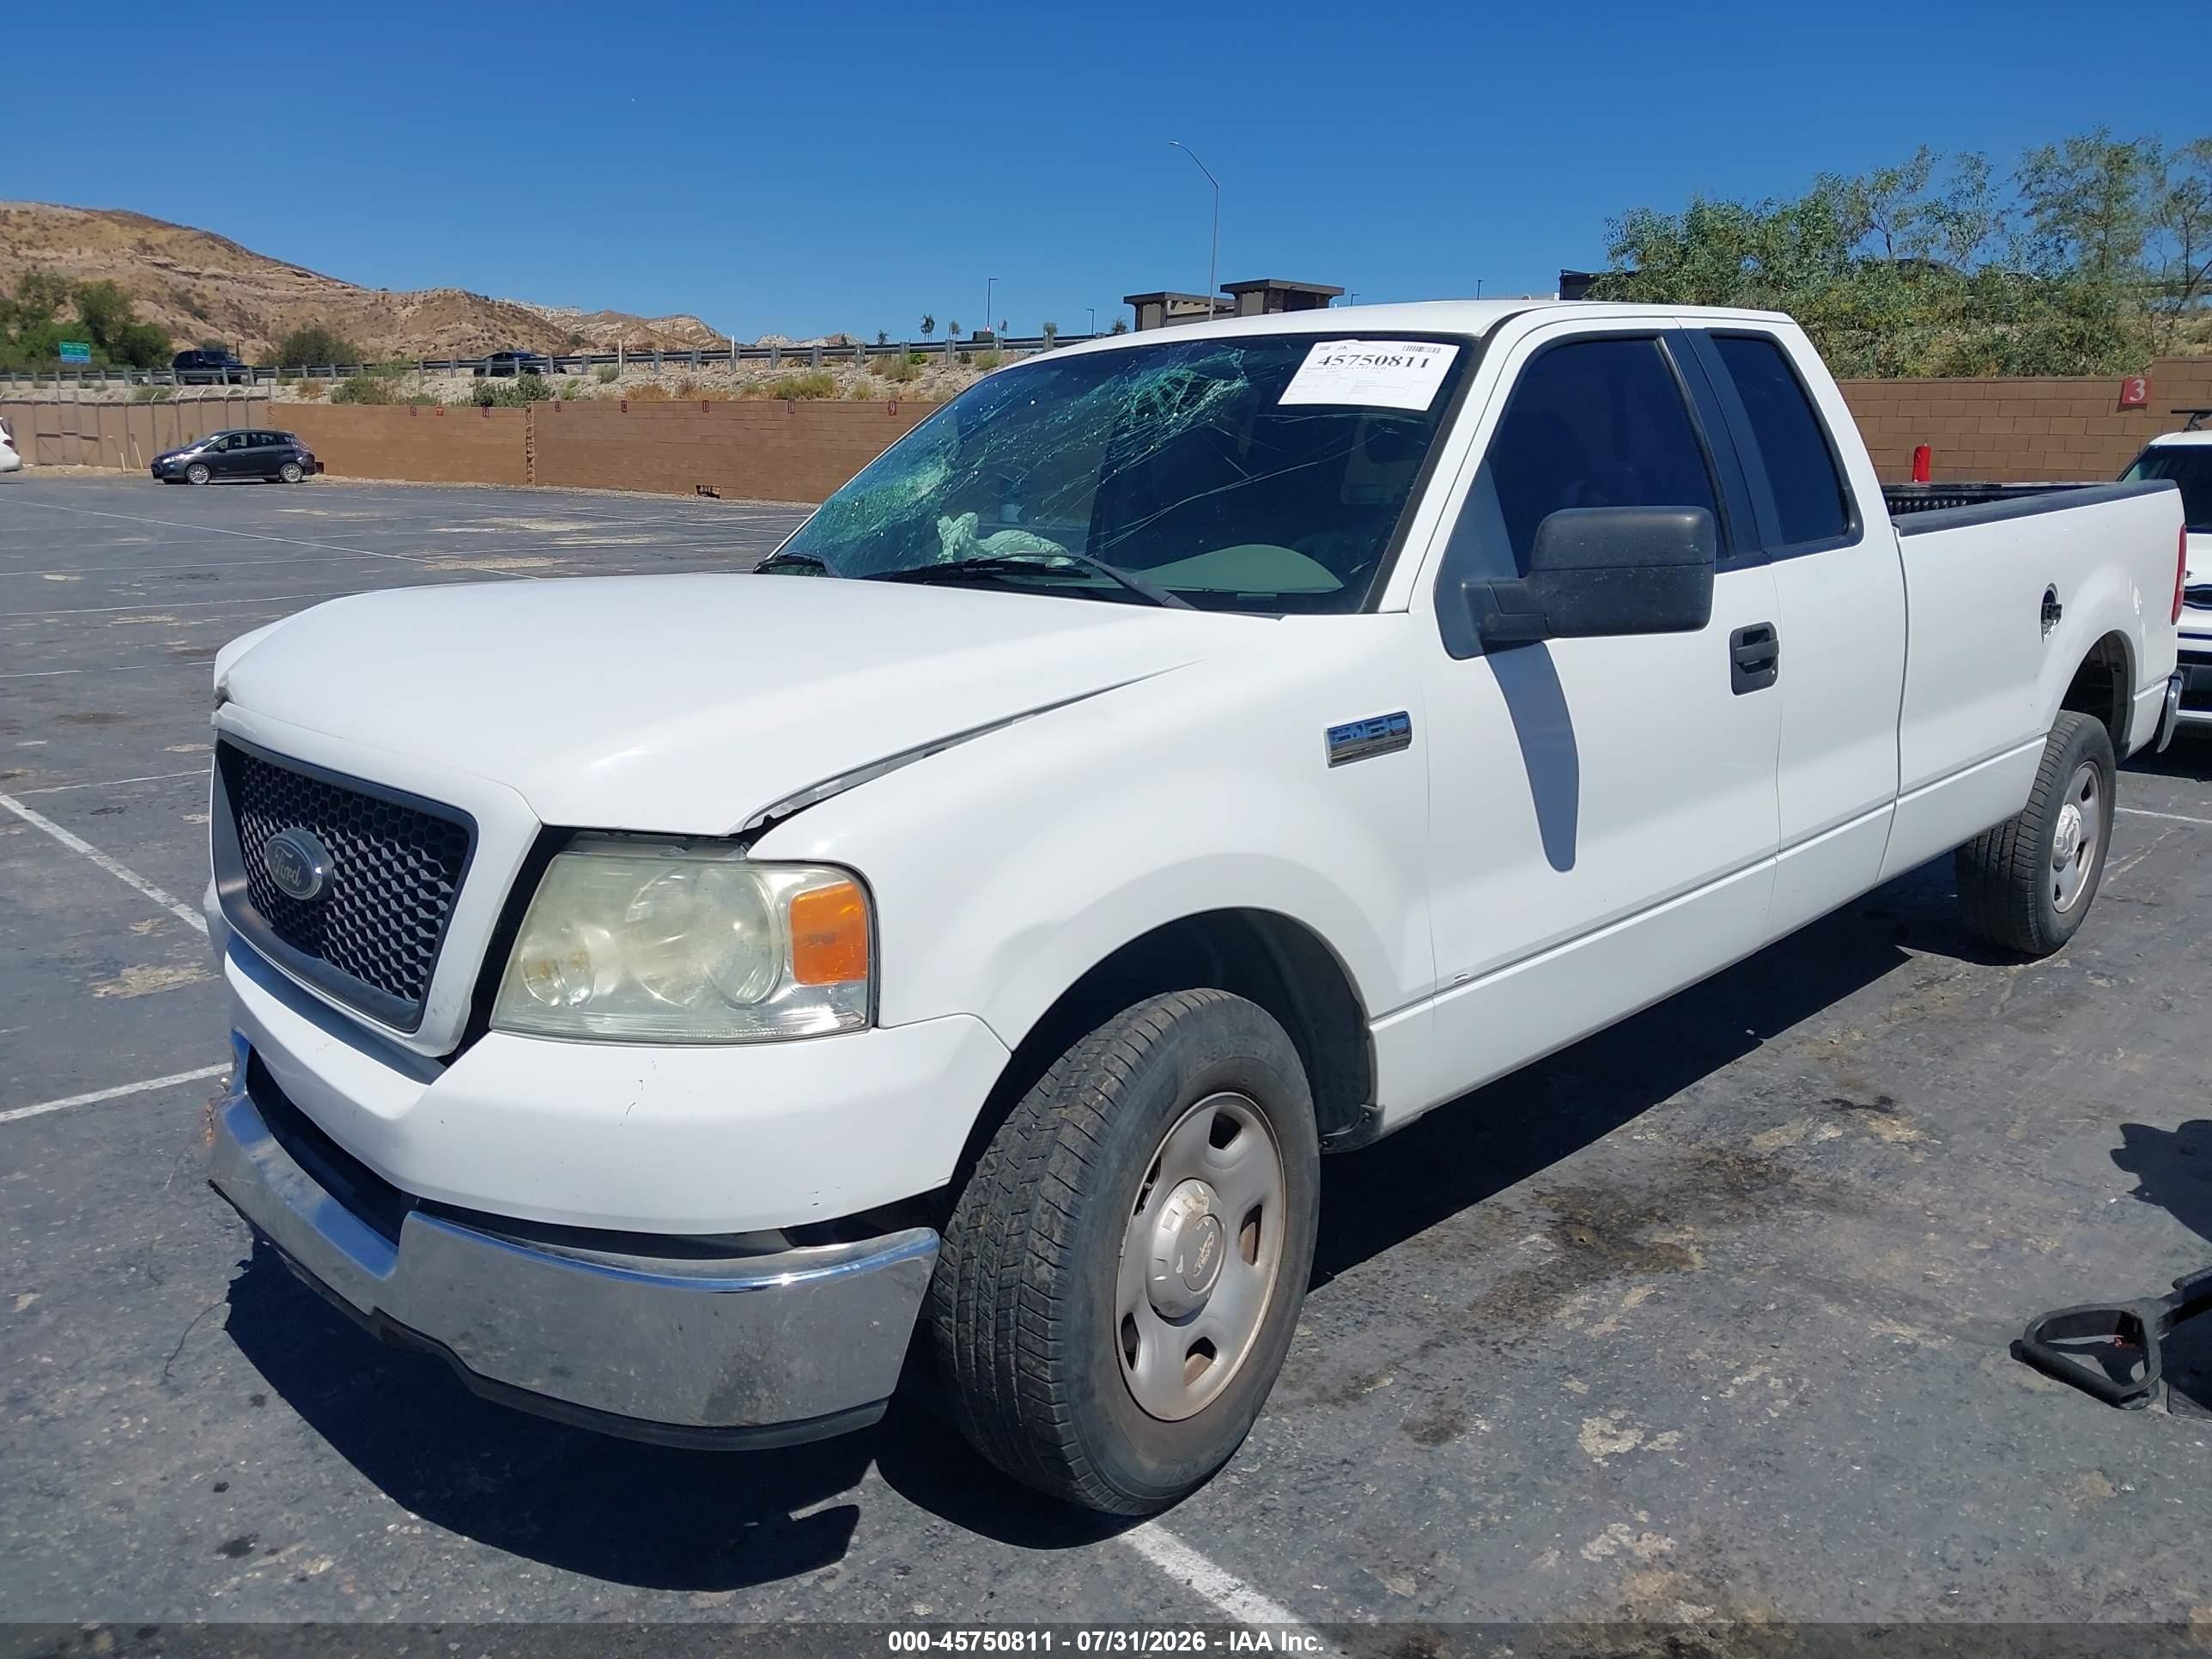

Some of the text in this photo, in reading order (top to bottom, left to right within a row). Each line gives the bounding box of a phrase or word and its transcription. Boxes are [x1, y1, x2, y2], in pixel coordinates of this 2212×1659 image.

[1317, 354, 1431, 369] 45750811
[2129, 379, 2147, 402] 3
[274, 845, 302, 887] Ford
